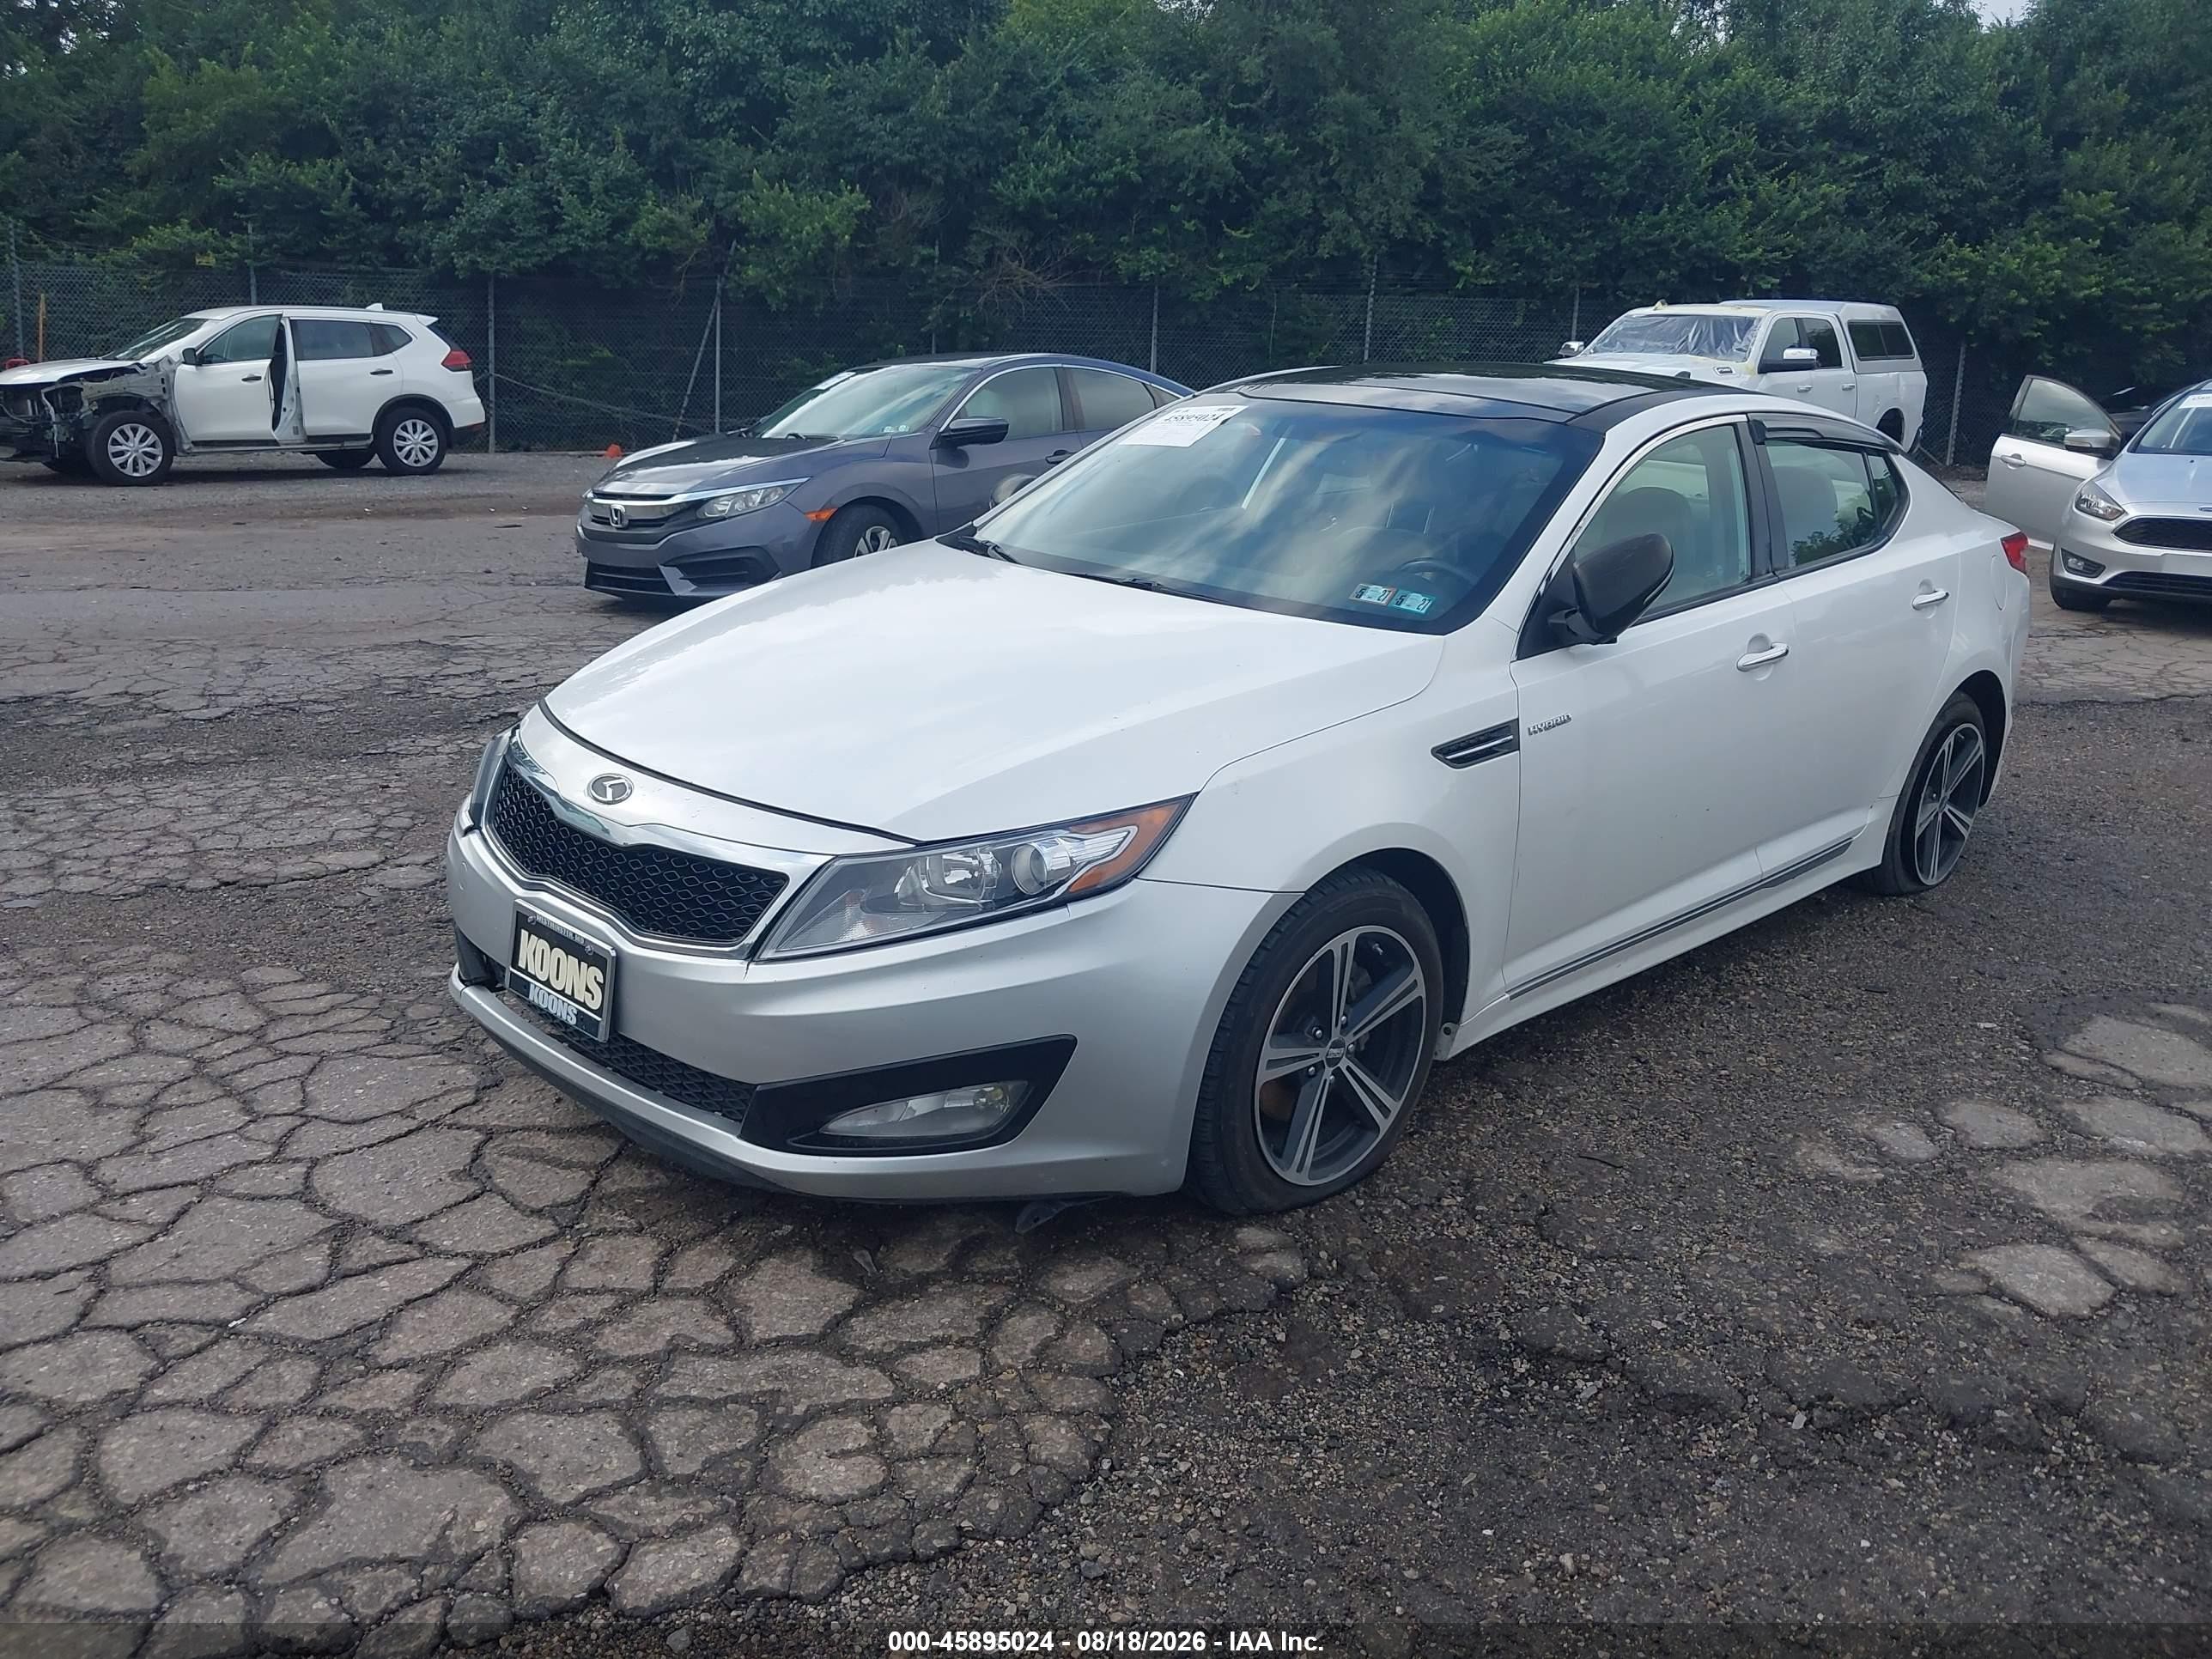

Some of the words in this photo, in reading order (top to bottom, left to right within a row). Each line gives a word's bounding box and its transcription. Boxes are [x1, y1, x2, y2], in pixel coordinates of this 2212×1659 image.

[1377, 589, 1391, 603] 27
[1416, 598, 1431, 611] 27
[1527, 713, 1573, 736] HYBRID
[518, 928, 604, 1011] KOONS
[528, 983, 578, 1025] KOONS
